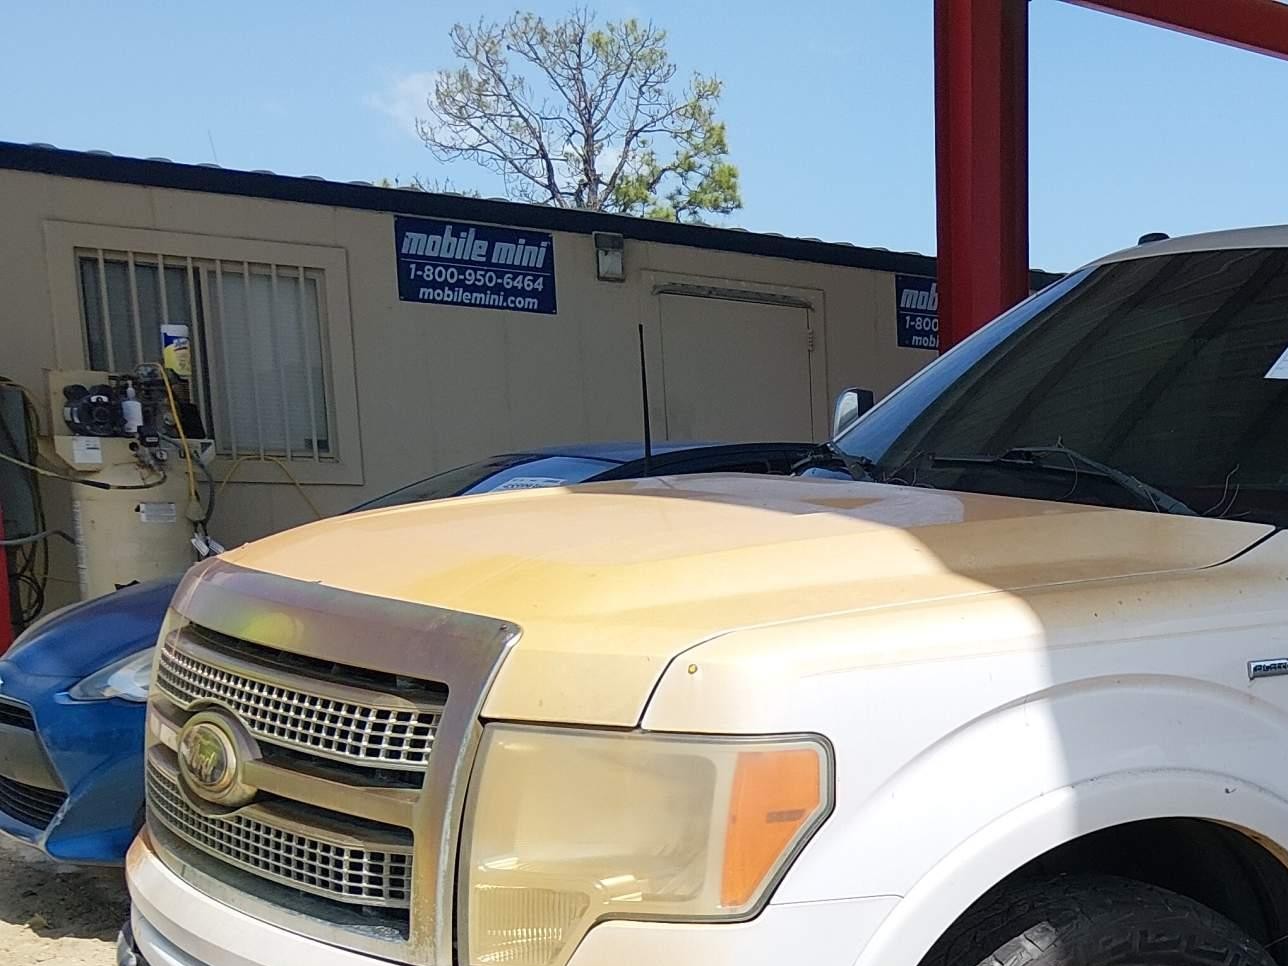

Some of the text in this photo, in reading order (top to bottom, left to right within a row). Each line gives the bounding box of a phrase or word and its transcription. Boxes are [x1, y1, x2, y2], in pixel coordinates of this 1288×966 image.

[401, 225, 548, 268] mobile mini
[409, 264, 543, 292] 1-800-950-6464
[419, 287, 537, 309] mobilemini.com
